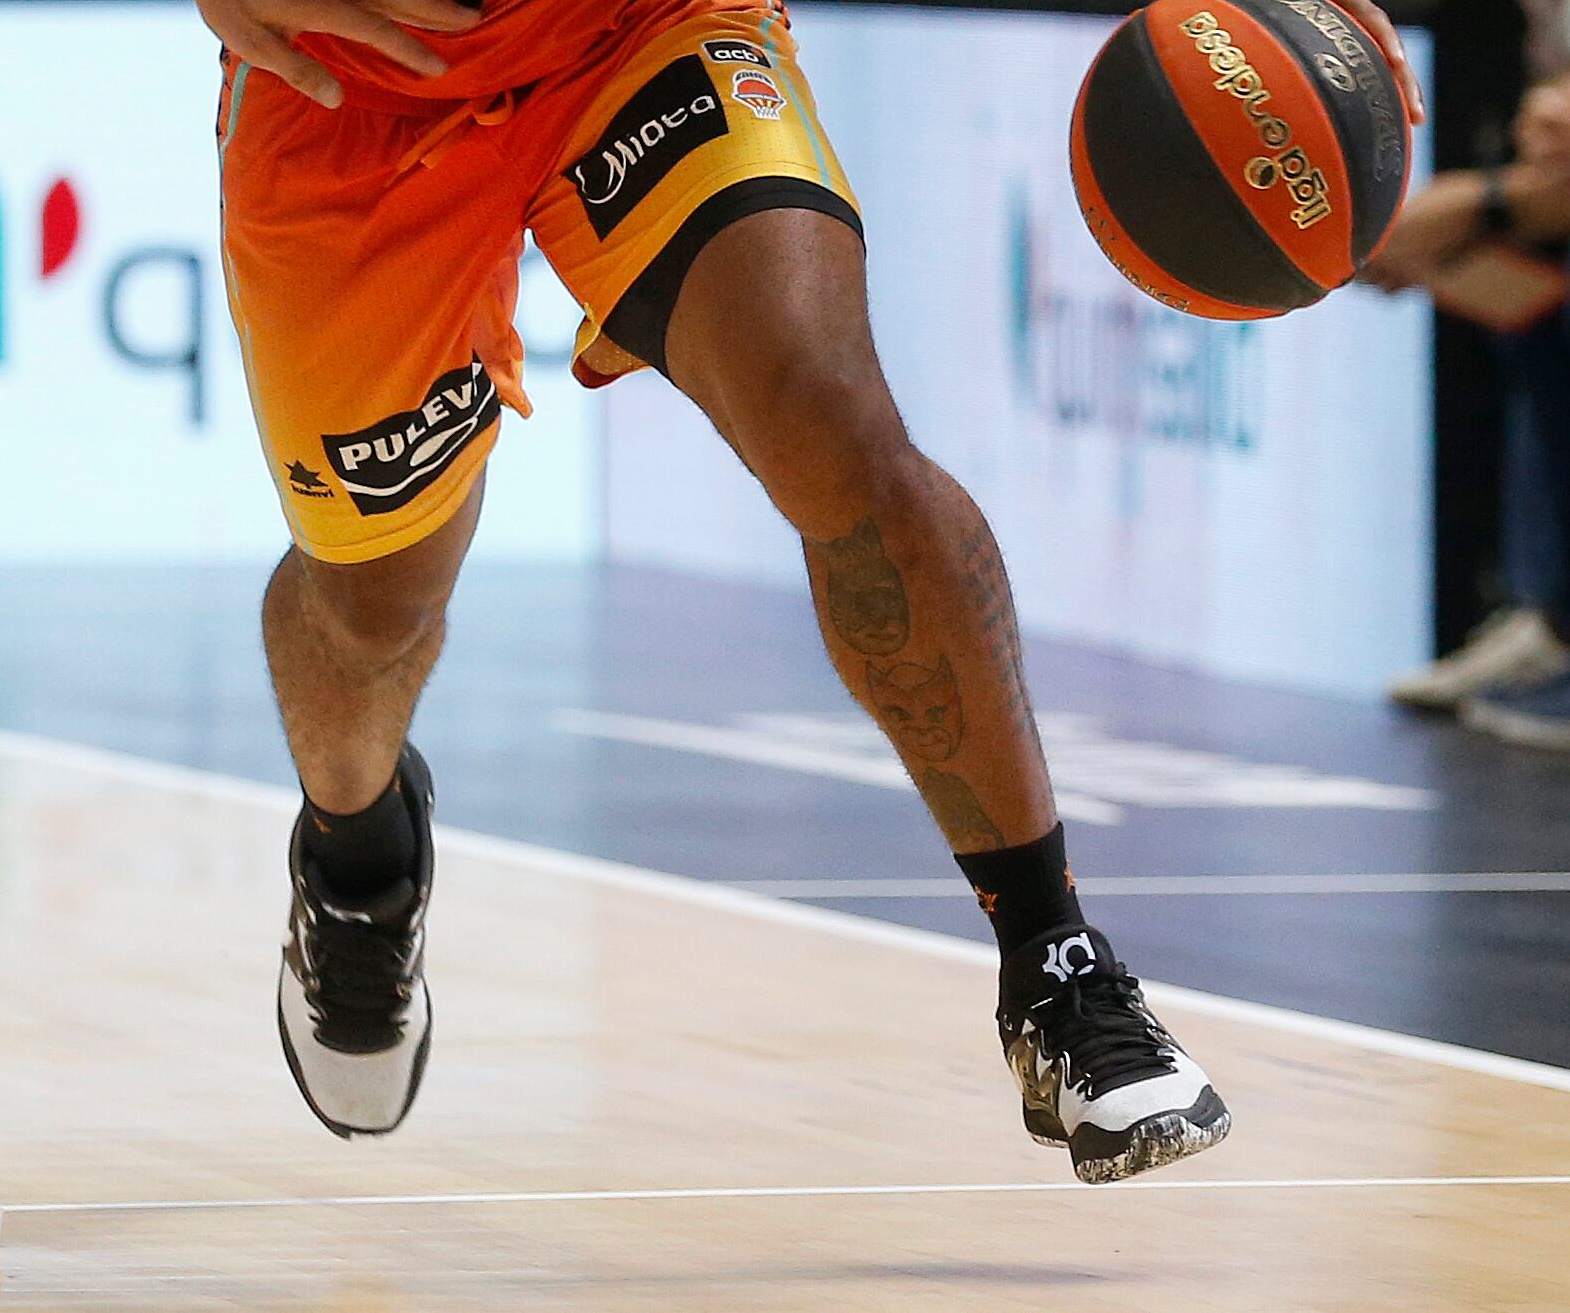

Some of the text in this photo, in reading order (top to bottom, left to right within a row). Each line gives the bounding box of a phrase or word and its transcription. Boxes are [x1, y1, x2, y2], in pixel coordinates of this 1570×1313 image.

[714, 48, 760, 63] acb
[1180, 11, 1333, 230] liga endesa
